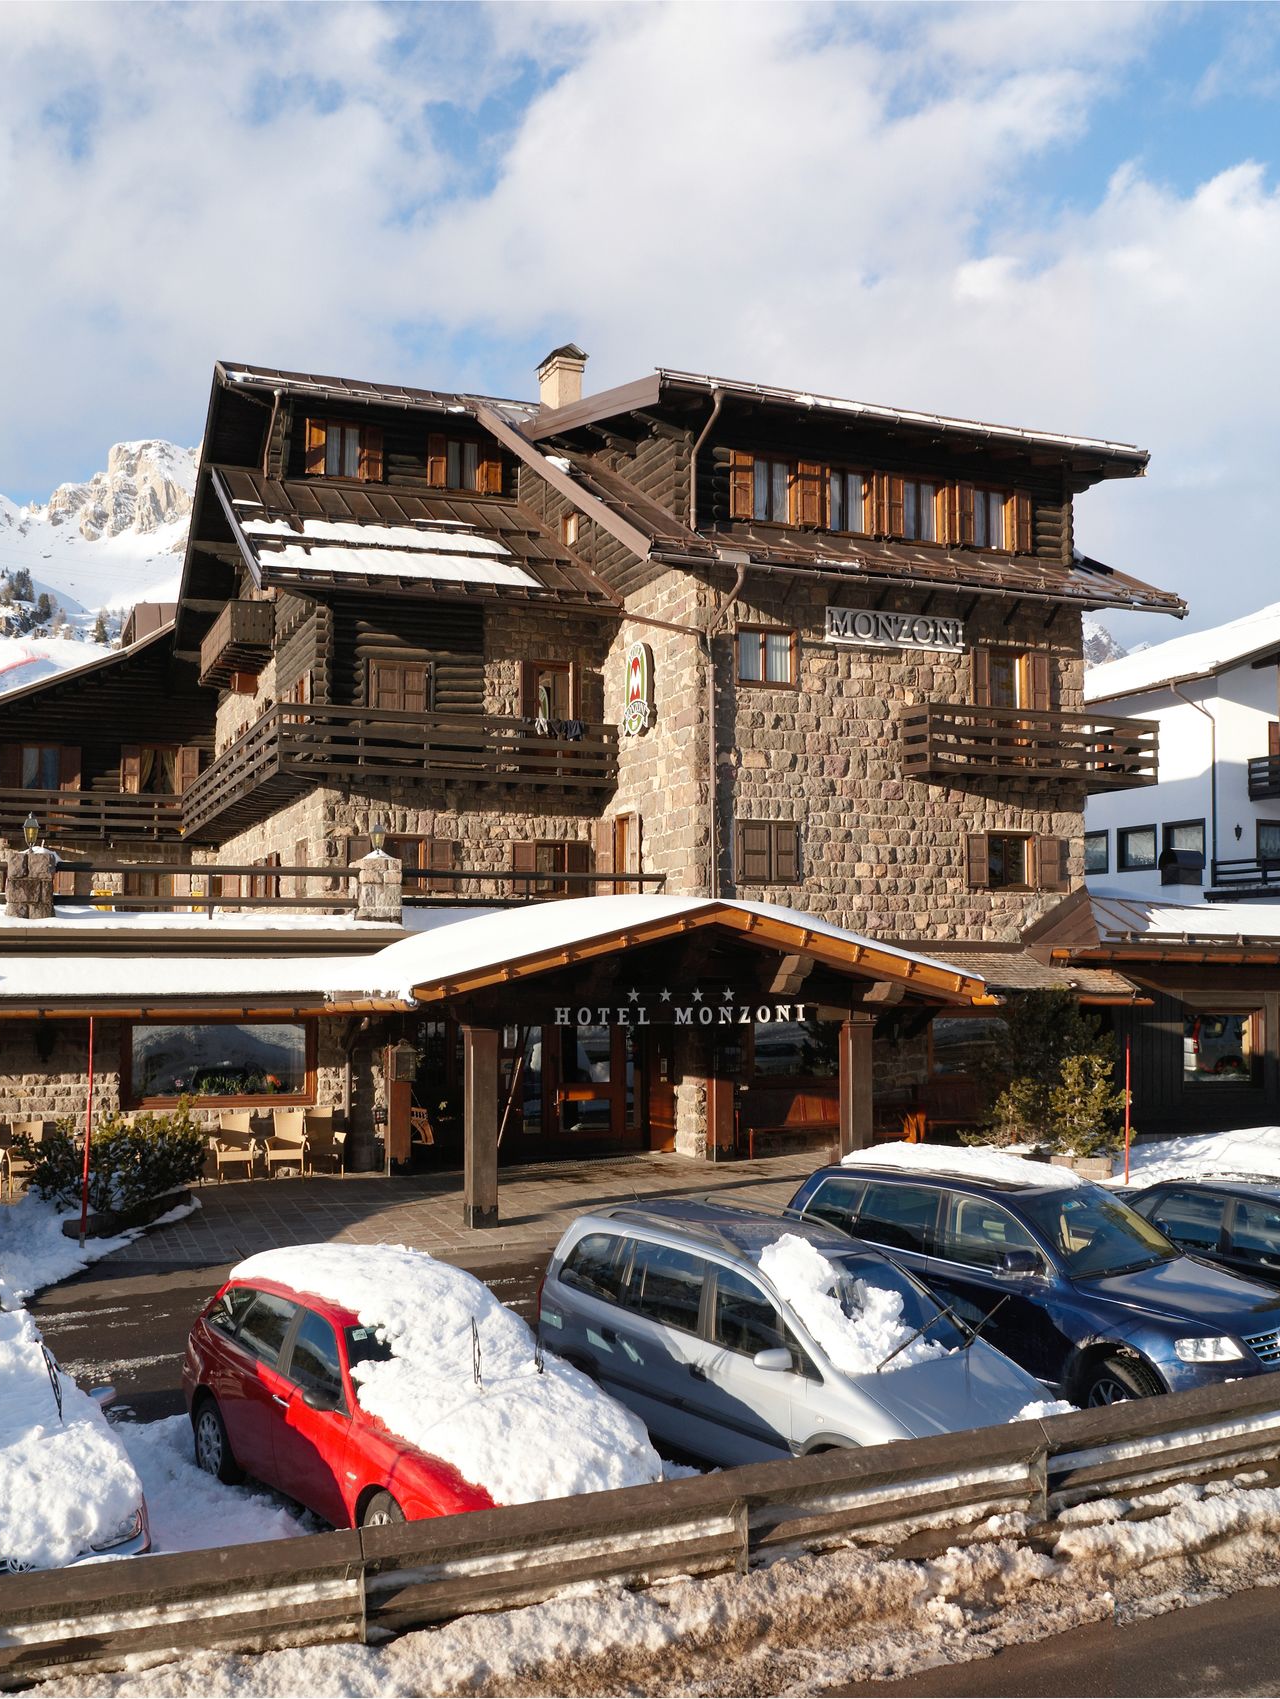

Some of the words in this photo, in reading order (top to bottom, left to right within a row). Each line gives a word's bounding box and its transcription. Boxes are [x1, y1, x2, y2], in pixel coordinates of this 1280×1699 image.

[830, 609, 966, 647] MONZONI
[554, 1006, 651, 1026] HOTEL
[673, 1004, 807, 1025] MONZONI
